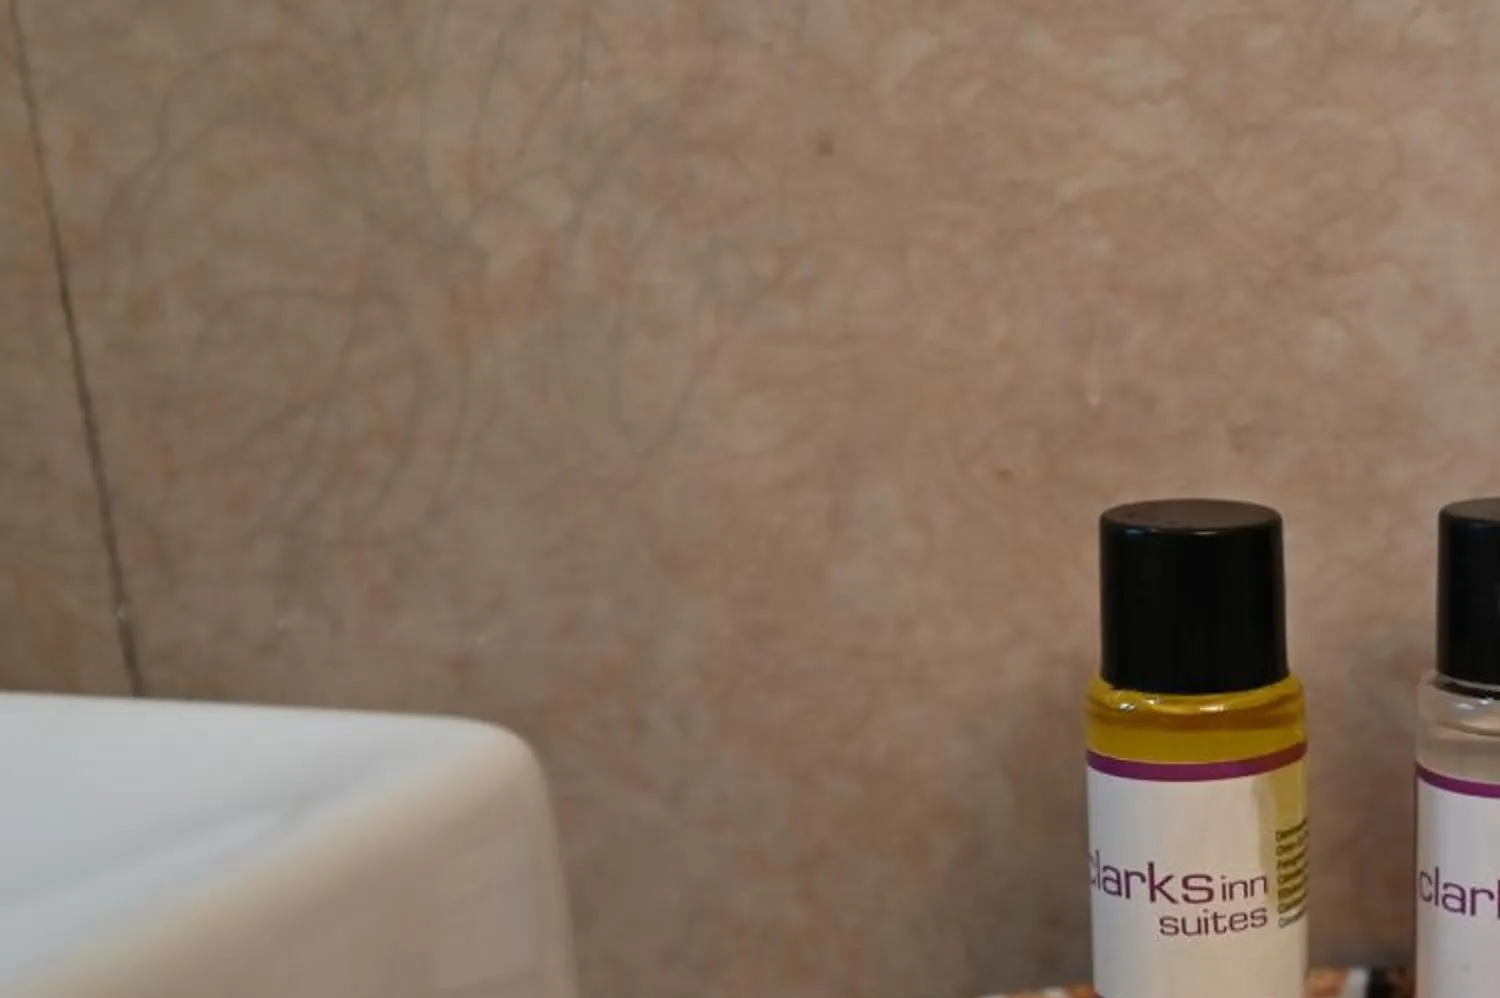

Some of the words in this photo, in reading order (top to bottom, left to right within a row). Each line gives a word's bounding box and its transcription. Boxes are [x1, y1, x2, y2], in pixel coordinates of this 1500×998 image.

[1090, 849, 1215, 905] larks
[1220, 874, 1269, 902] inn
[1159, 907, 1269, 937] suites
